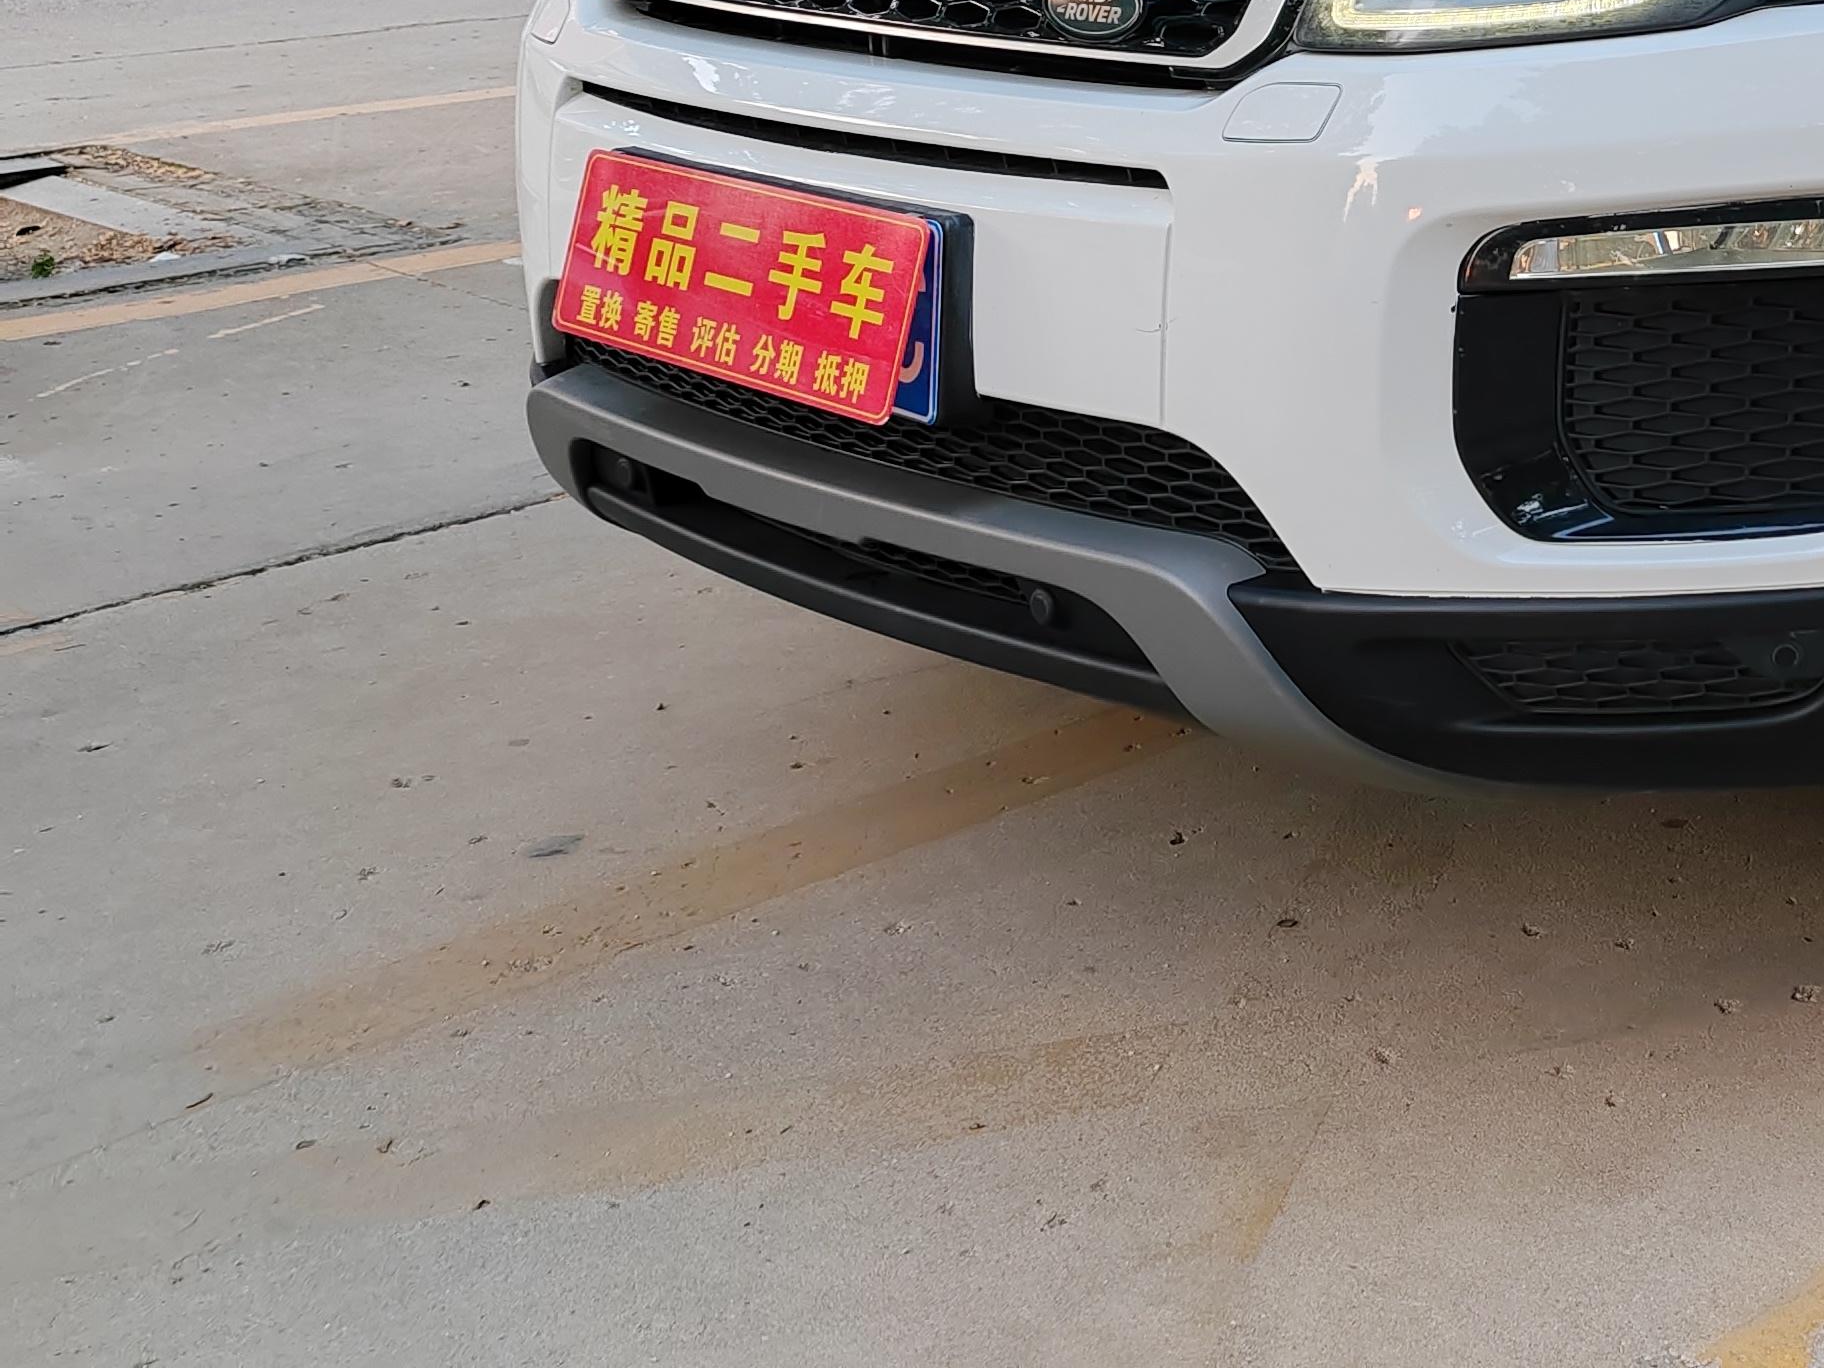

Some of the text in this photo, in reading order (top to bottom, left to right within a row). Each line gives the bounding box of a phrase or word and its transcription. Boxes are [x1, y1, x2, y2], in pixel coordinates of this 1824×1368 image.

[1064, 2, 1122, 24] ROVER
[590, 183, 895, 340] 精品二手车
[576, 286, 872, 404] 置换 寄售 评估 分期 抵押
